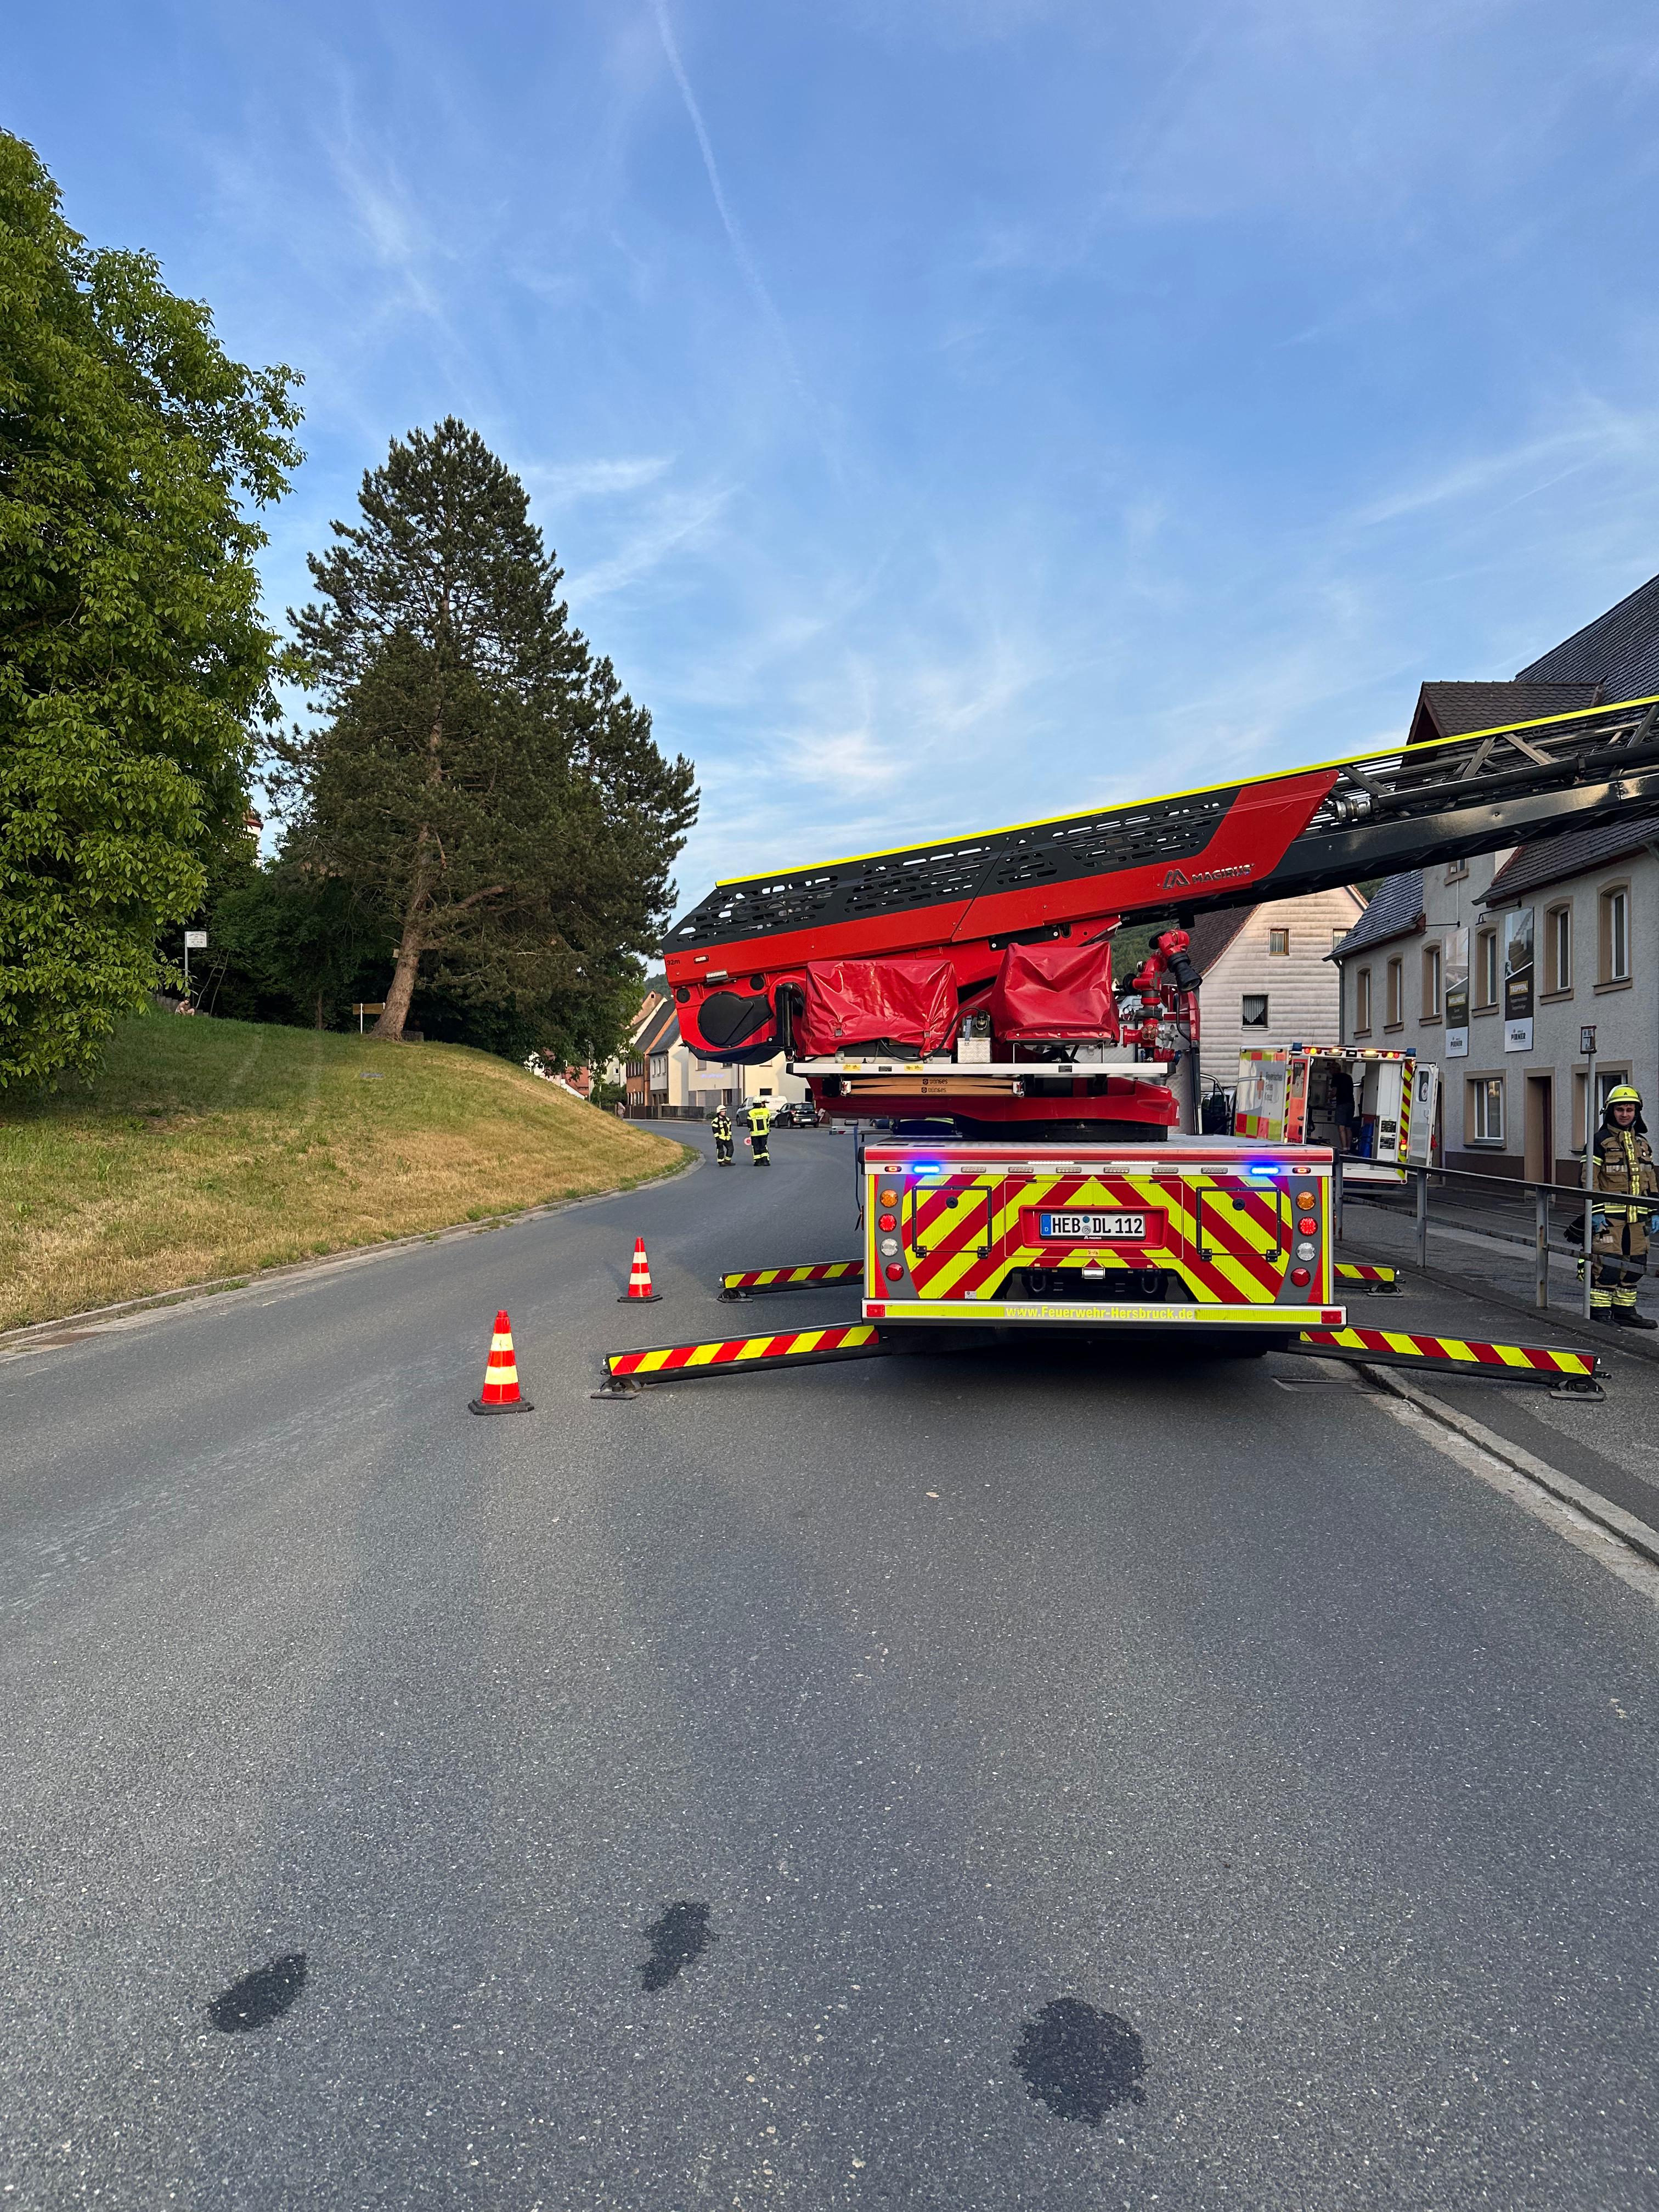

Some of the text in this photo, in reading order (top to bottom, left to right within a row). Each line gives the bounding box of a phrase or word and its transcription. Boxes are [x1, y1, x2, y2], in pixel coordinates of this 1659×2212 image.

[1192, 864, 1251, 884] MAGIRUS
[1052, 1217, 1143, 1234] HEB DL 112
[1006, 1306, 1194, 1319] www.Feuerwehr-Hersbruck.de
